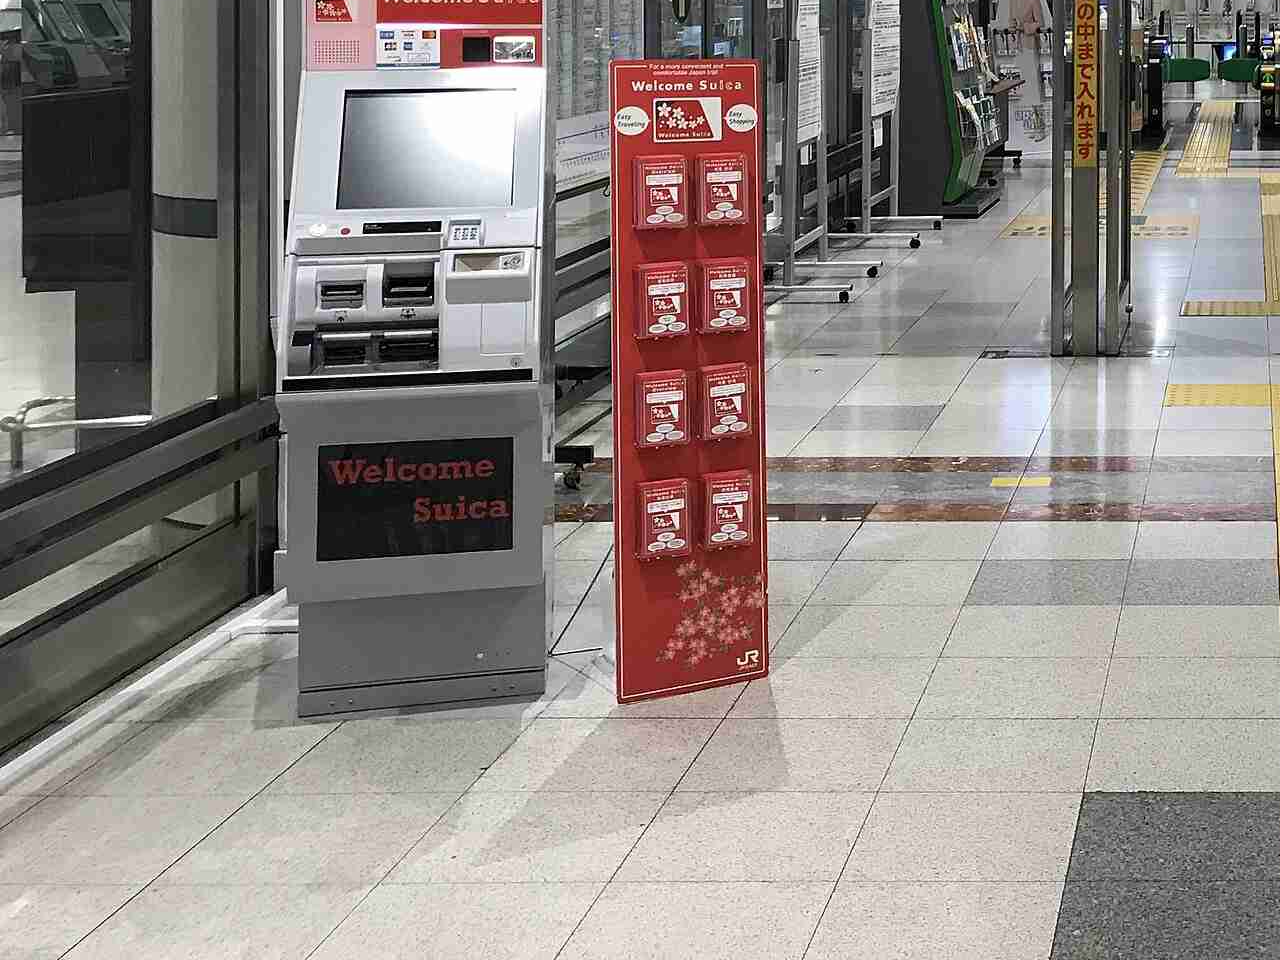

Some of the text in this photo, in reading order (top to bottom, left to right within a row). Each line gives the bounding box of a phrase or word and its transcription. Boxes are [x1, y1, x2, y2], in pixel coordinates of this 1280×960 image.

[631, 79, 744, 92] Welcome Suica
[328, 458, 497, 485] Welcome
[413, 495, 510, 522] Suica
[736, 650, 760, 665] JR
